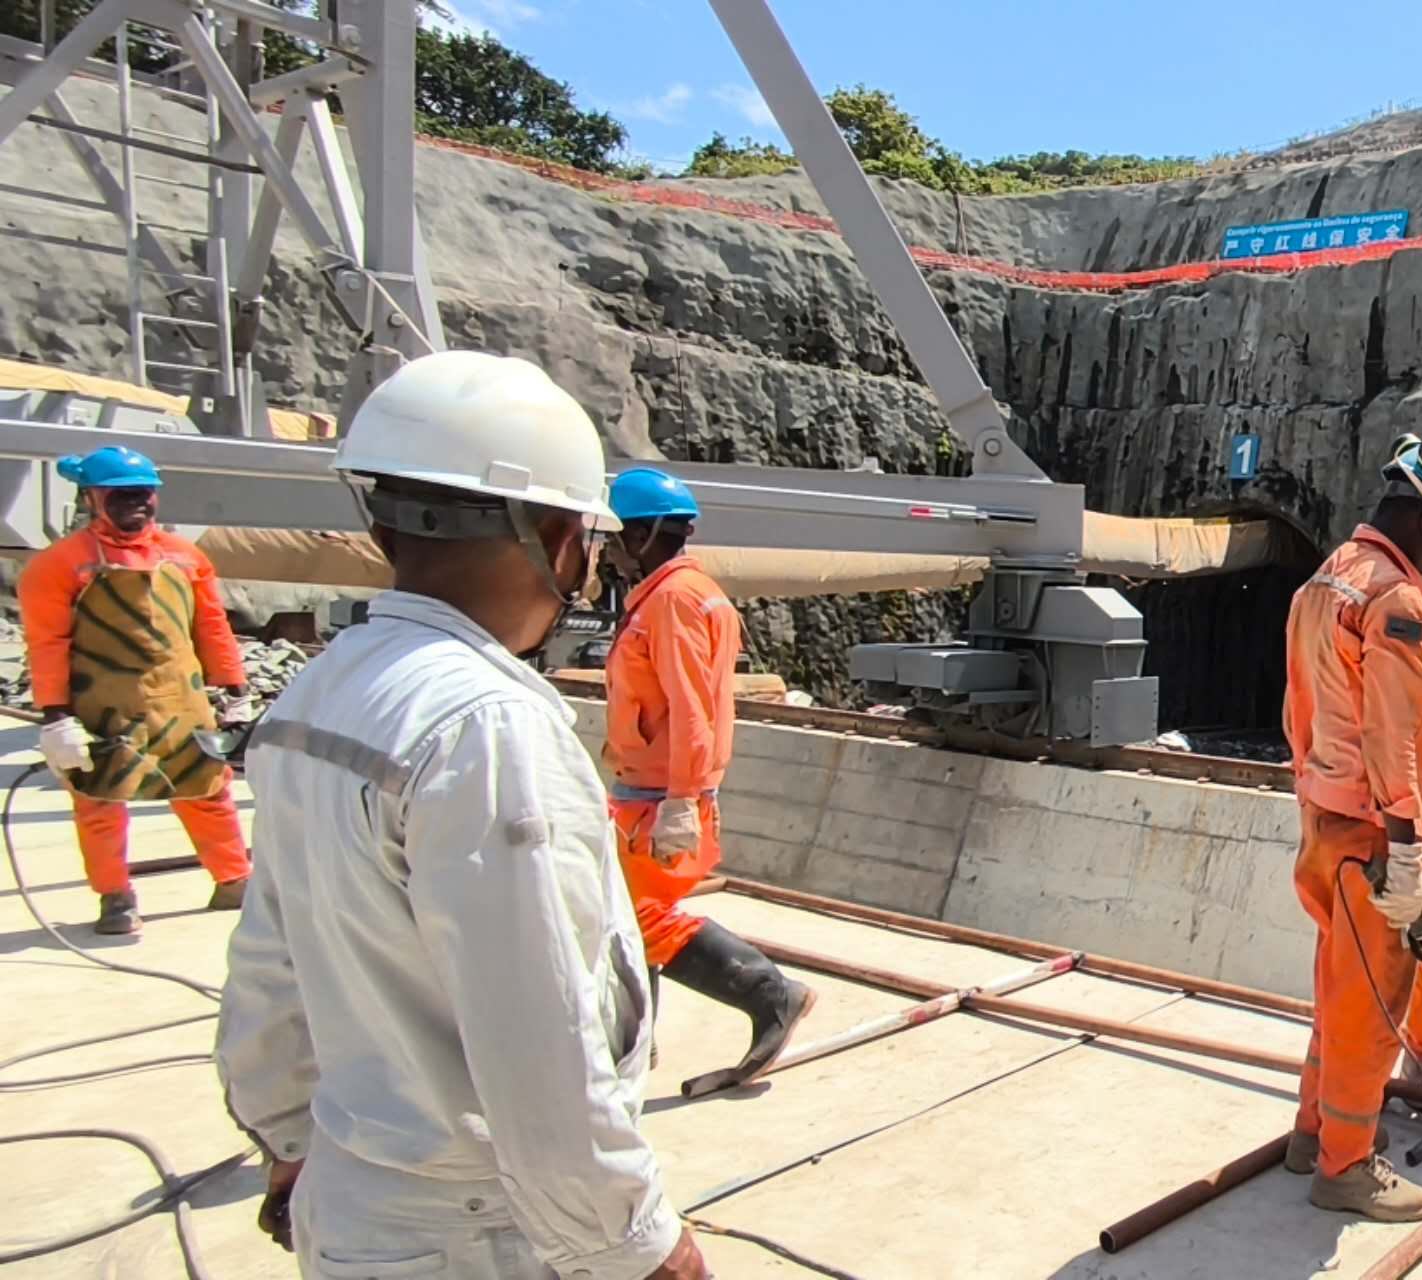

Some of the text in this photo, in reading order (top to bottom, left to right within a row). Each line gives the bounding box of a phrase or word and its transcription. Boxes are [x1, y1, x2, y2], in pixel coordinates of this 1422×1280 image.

[1351, 215, 1360, 225] de
[1361, 212, 1403, 225] segurança
[1236, 439, 1251, 474] 1
